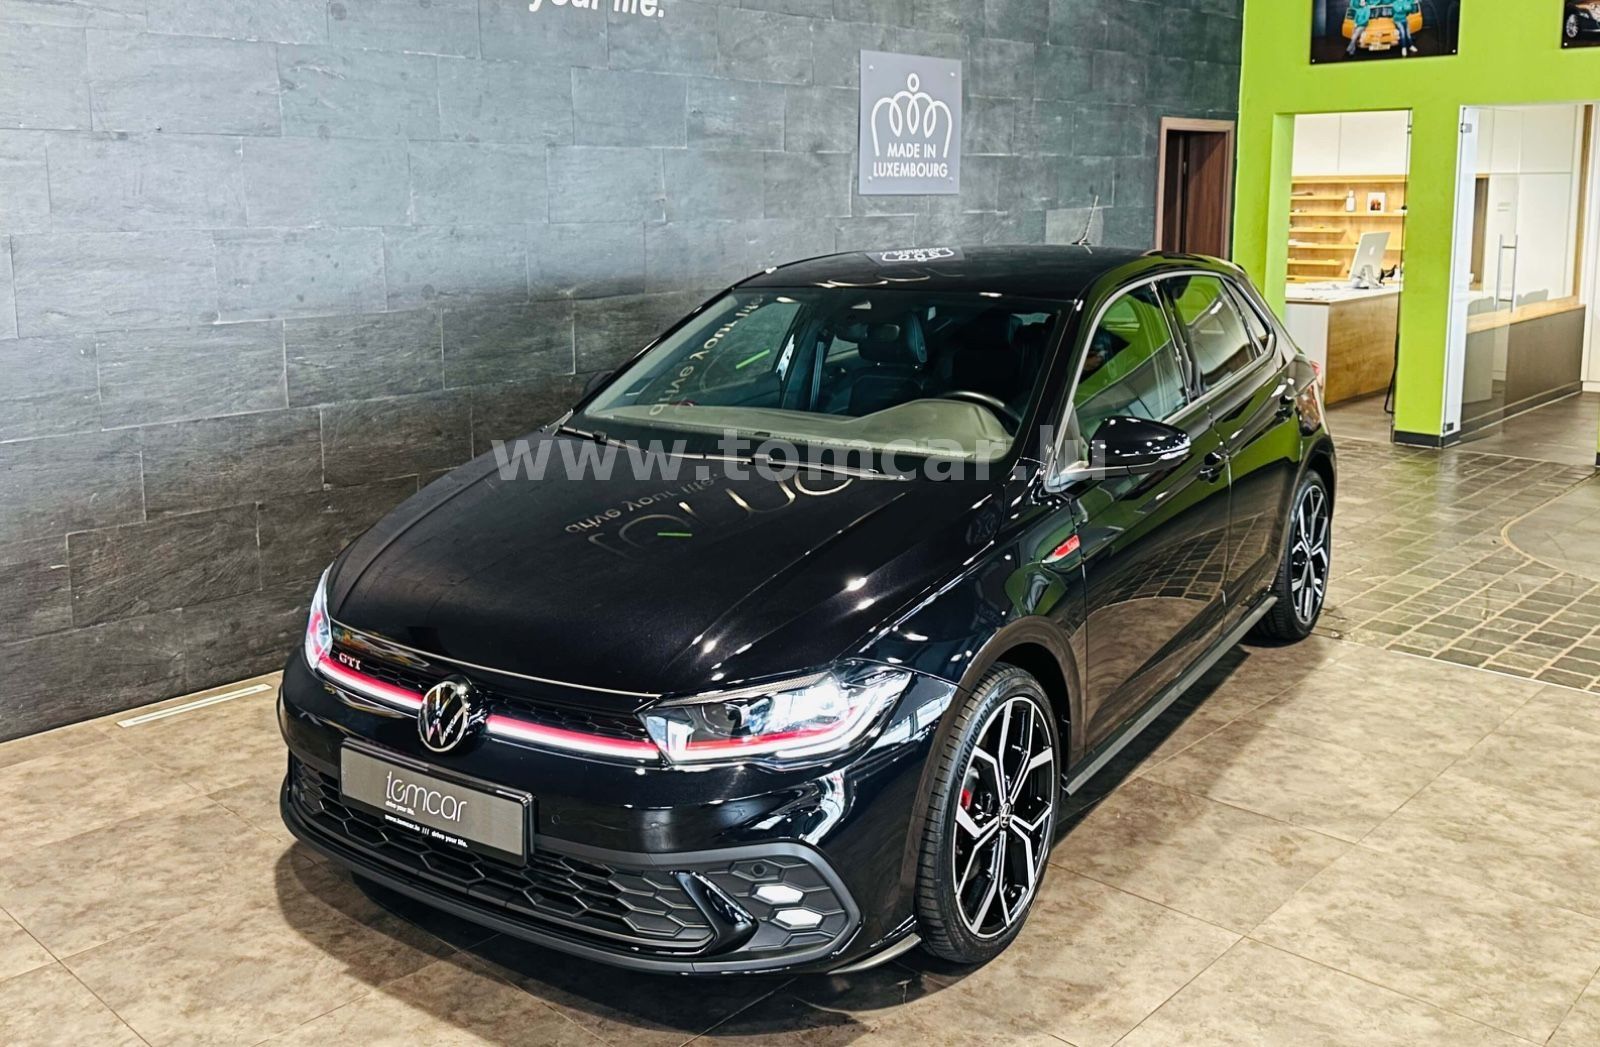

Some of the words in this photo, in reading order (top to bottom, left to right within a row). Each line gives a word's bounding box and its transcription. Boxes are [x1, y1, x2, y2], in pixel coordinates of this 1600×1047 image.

[887, 142, 920, 158] MADE
[923, 143, 937, 159] IN
[872, 161, 949, 178] LUXEMBOURG
[339, 652, 361, 670] GTI
[386, 771, 468, 822] tomcar
